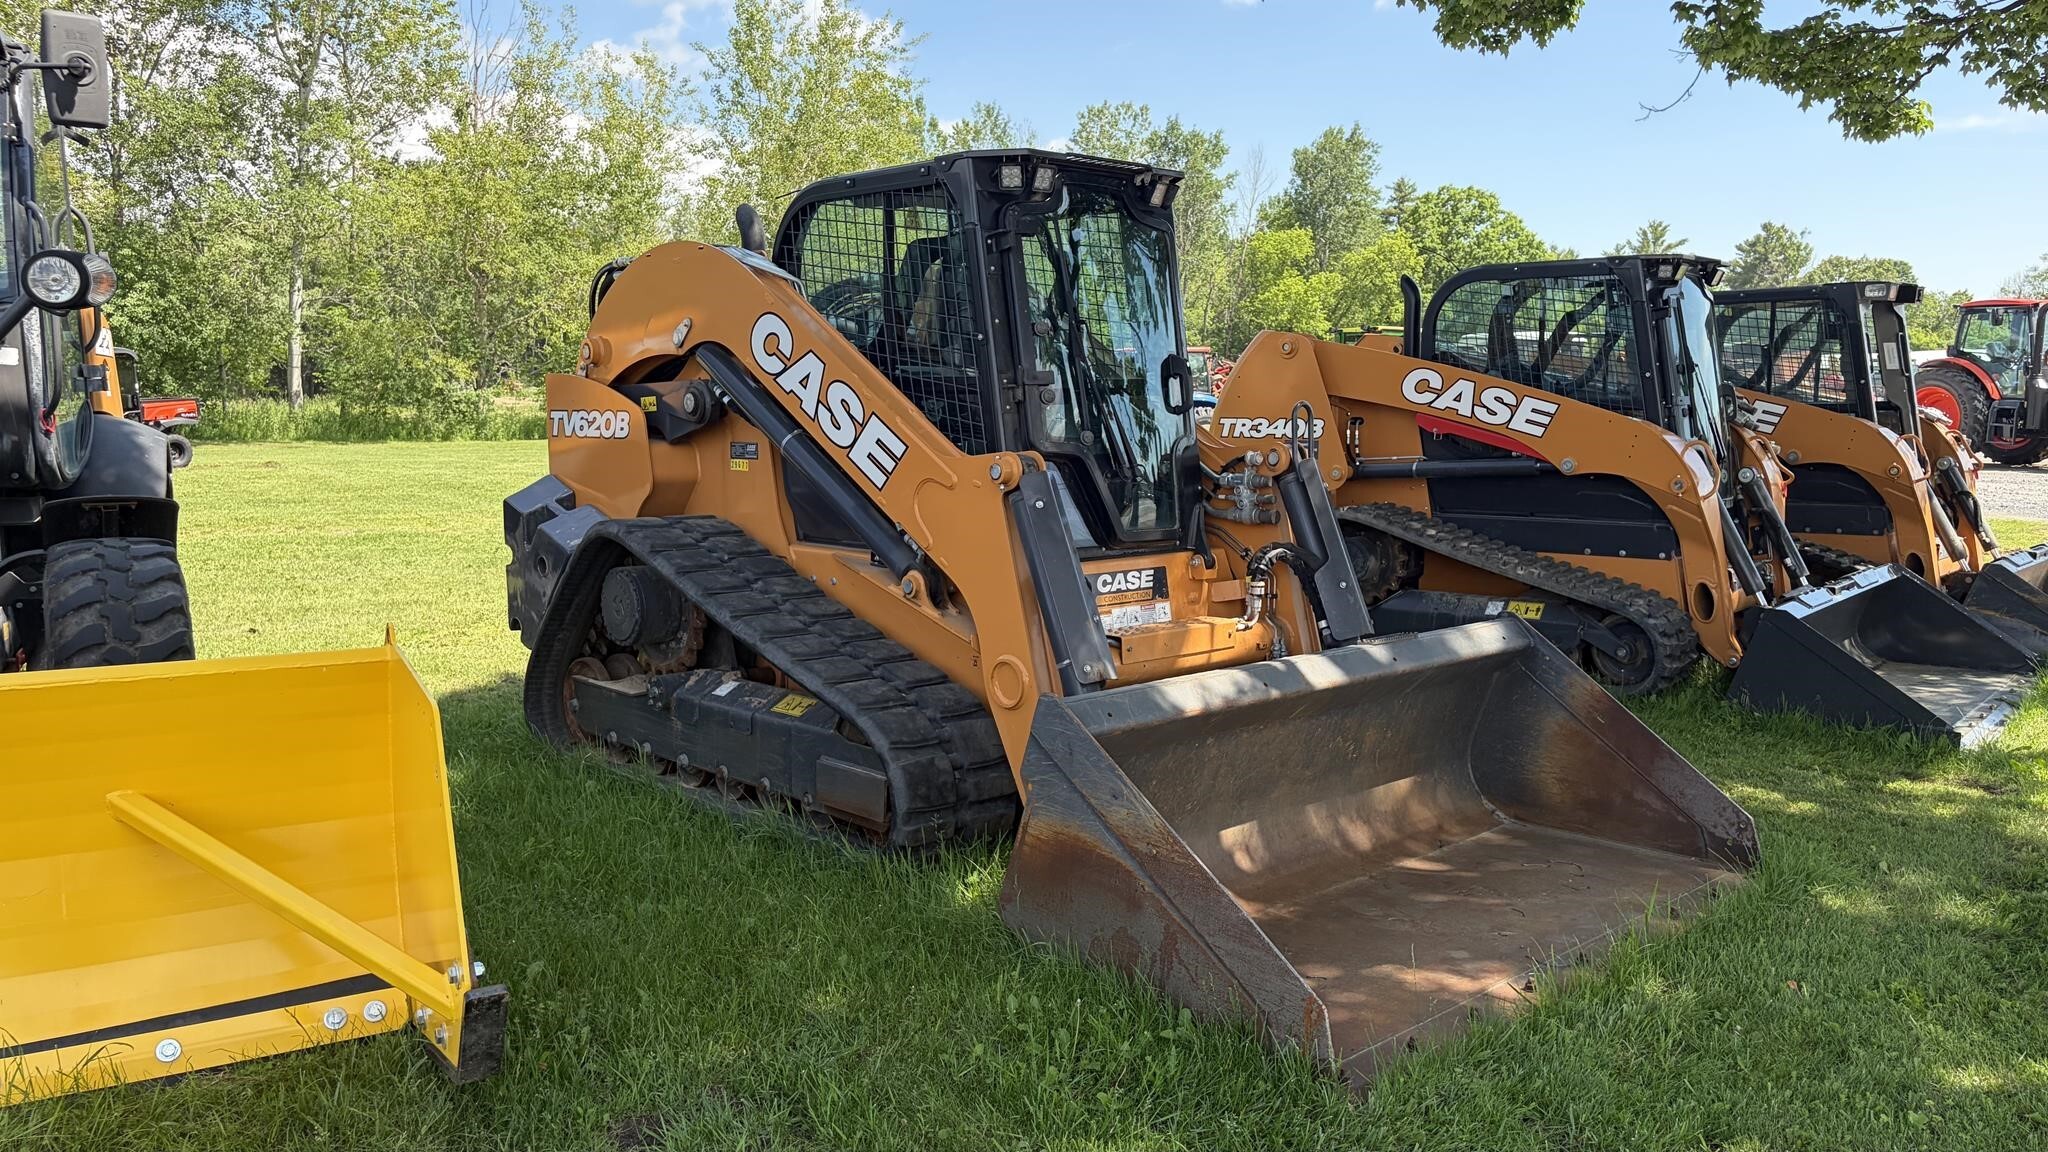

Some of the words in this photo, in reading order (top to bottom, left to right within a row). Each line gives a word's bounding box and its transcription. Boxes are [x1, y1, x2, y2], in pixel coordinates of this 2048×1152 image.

[751, 311, 909, 491] CASE
[1401, 367, 1560, 438] CASE
[550, 409, 630, 439] TV620B
[1219, 417, 1325, 439] TR340B
[1096, 569, 1154, 593] CASE
[1103, 591, 1151, 603] CONSTRUCTION
